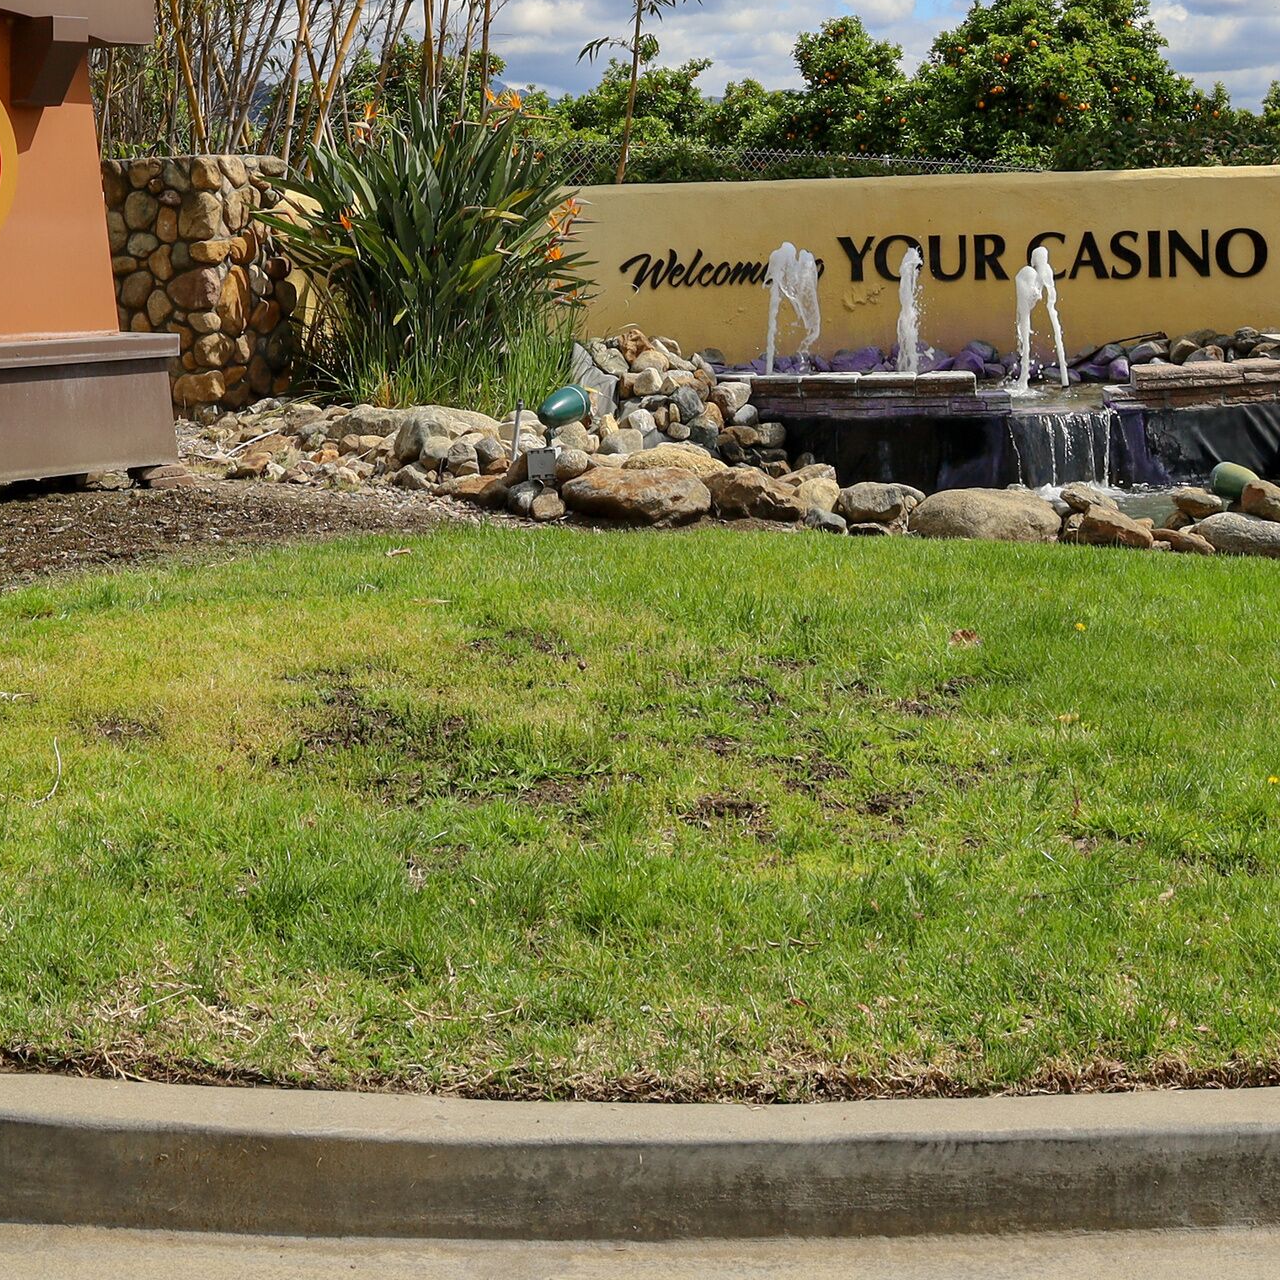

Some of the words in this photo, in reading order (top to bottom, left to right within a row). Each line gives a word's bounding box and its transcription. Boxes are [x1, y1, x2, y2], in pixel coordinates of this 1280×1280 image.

[619, 248, 780, 293] Welcom
[836, 233, 1011, 283] YOUR
[1026, 226, 1269, 280] CASINO
